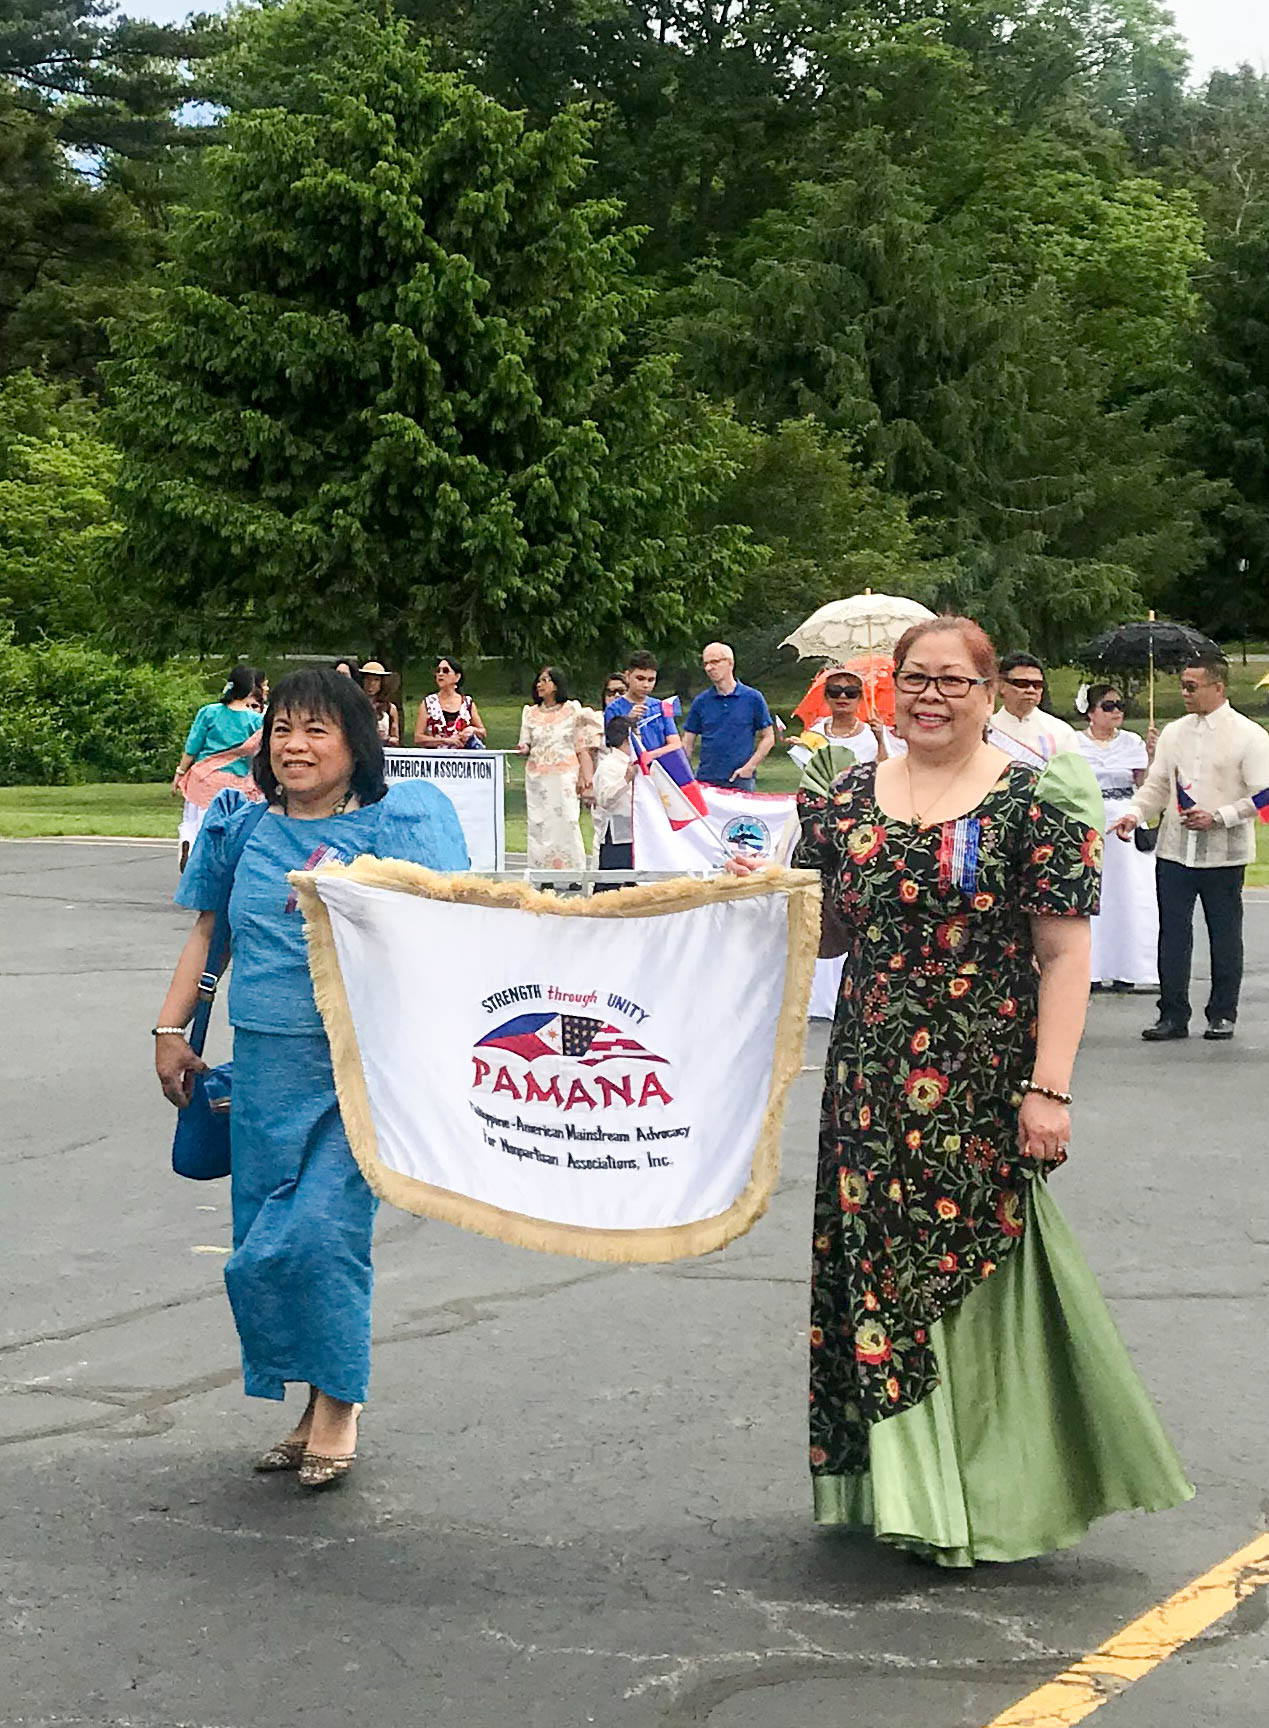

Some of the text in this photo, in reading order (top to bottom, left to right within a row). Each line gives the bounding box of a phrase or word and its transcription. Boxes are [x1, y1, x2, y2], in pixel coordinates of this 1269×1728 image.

[434, 761, 492, 779] ASSOCIATION
[481, 984, 650, 1025] STRENGTH through UNITY
[472, 1056, 674, 1111] PAMANA
[565, 1124, 630, 1142] Mainstream
[636, 1126, 691, 1142] Advocacy
